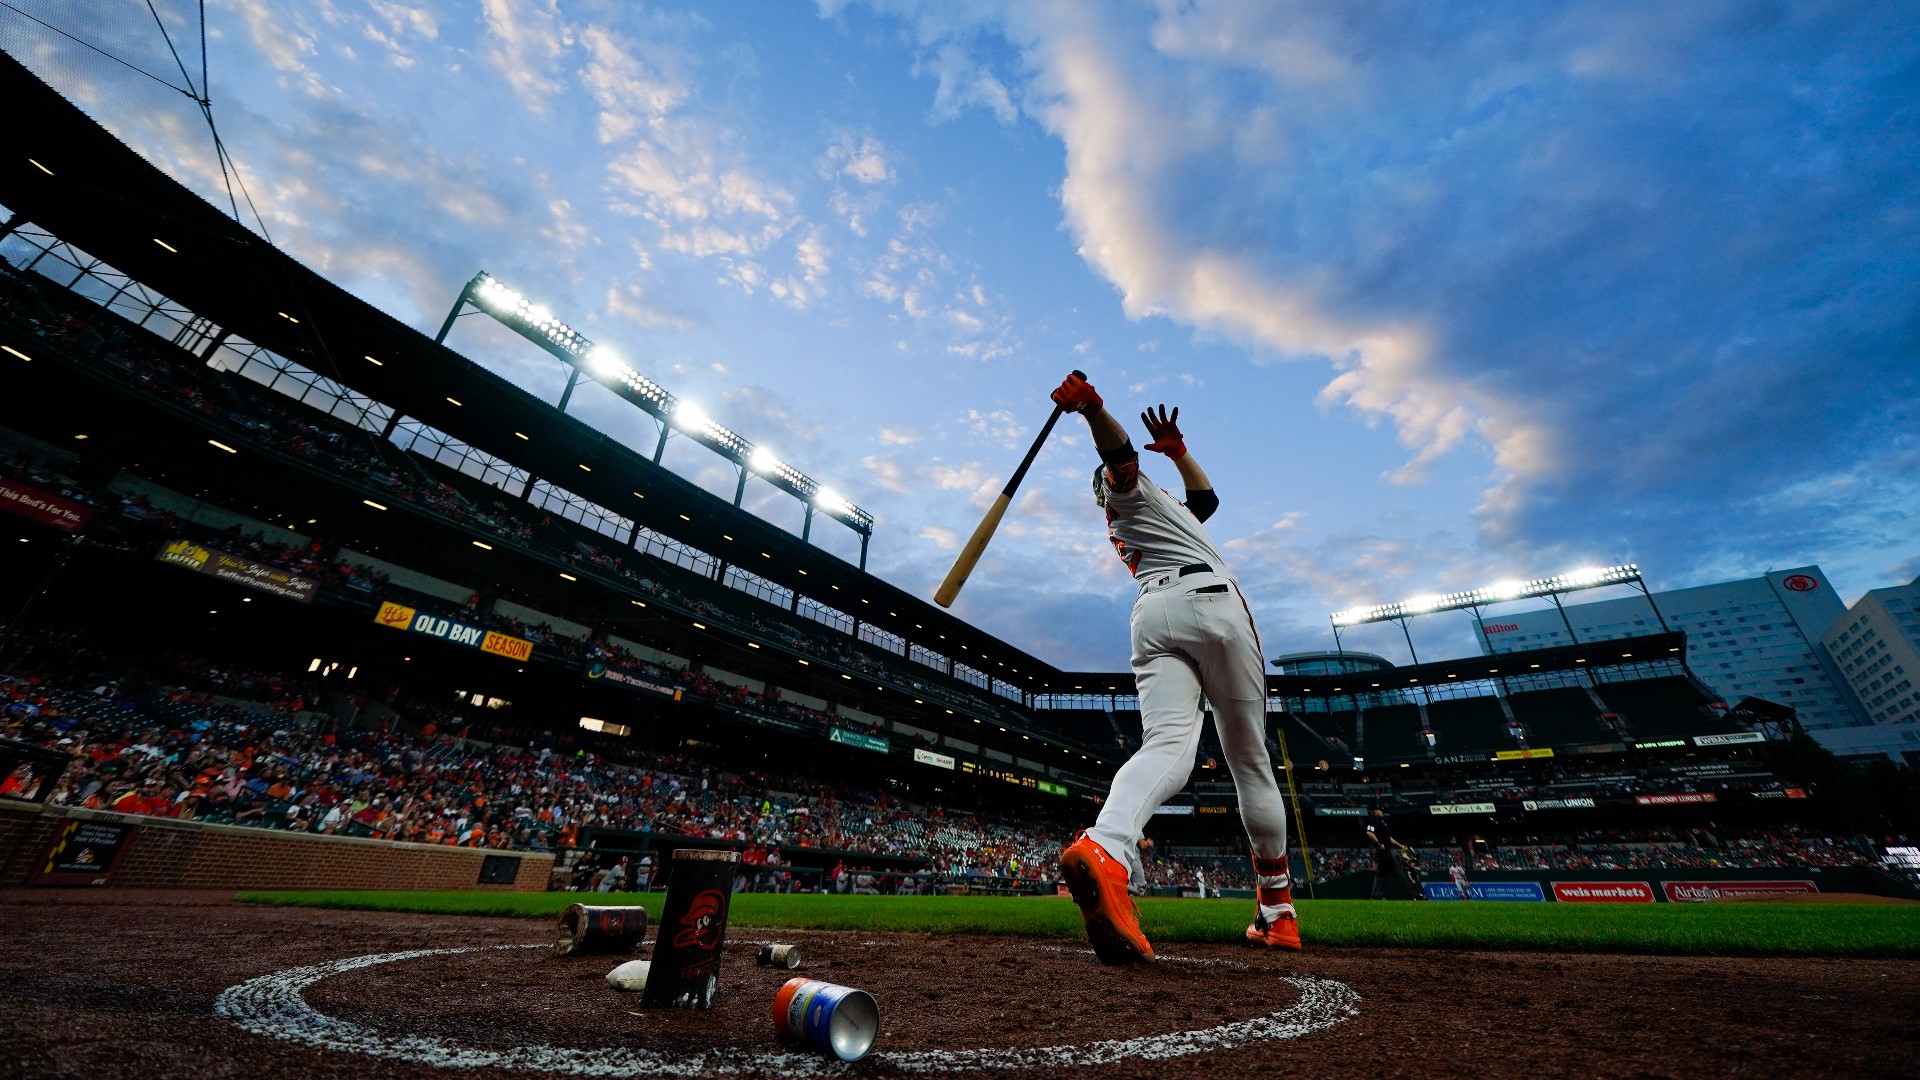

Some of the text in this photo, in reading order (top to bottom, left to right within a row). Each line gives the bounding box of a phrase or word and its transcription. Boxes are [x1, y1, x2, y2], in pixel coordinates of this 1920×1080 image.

[0, 486, 20, 500] This
[18, 494, 47, 510] Bud's
[45, 504, 65, 515] For
[166, 553, 201, 568] SAFFER
[216, 568, 306, 600] SafferPlumbing.com
[414, 614, 482, 647] OLD BAY
[1484, 624, 1519, 634] Hilton
[486, 633, 529, 658] SEASON
[1434, 755, 1466, 765] GANZ
[1563, 797, 1596, 808] UNION
[1429, 886, 1484, 898] LECM
[1560, 886, 1646, 898] weis markets
